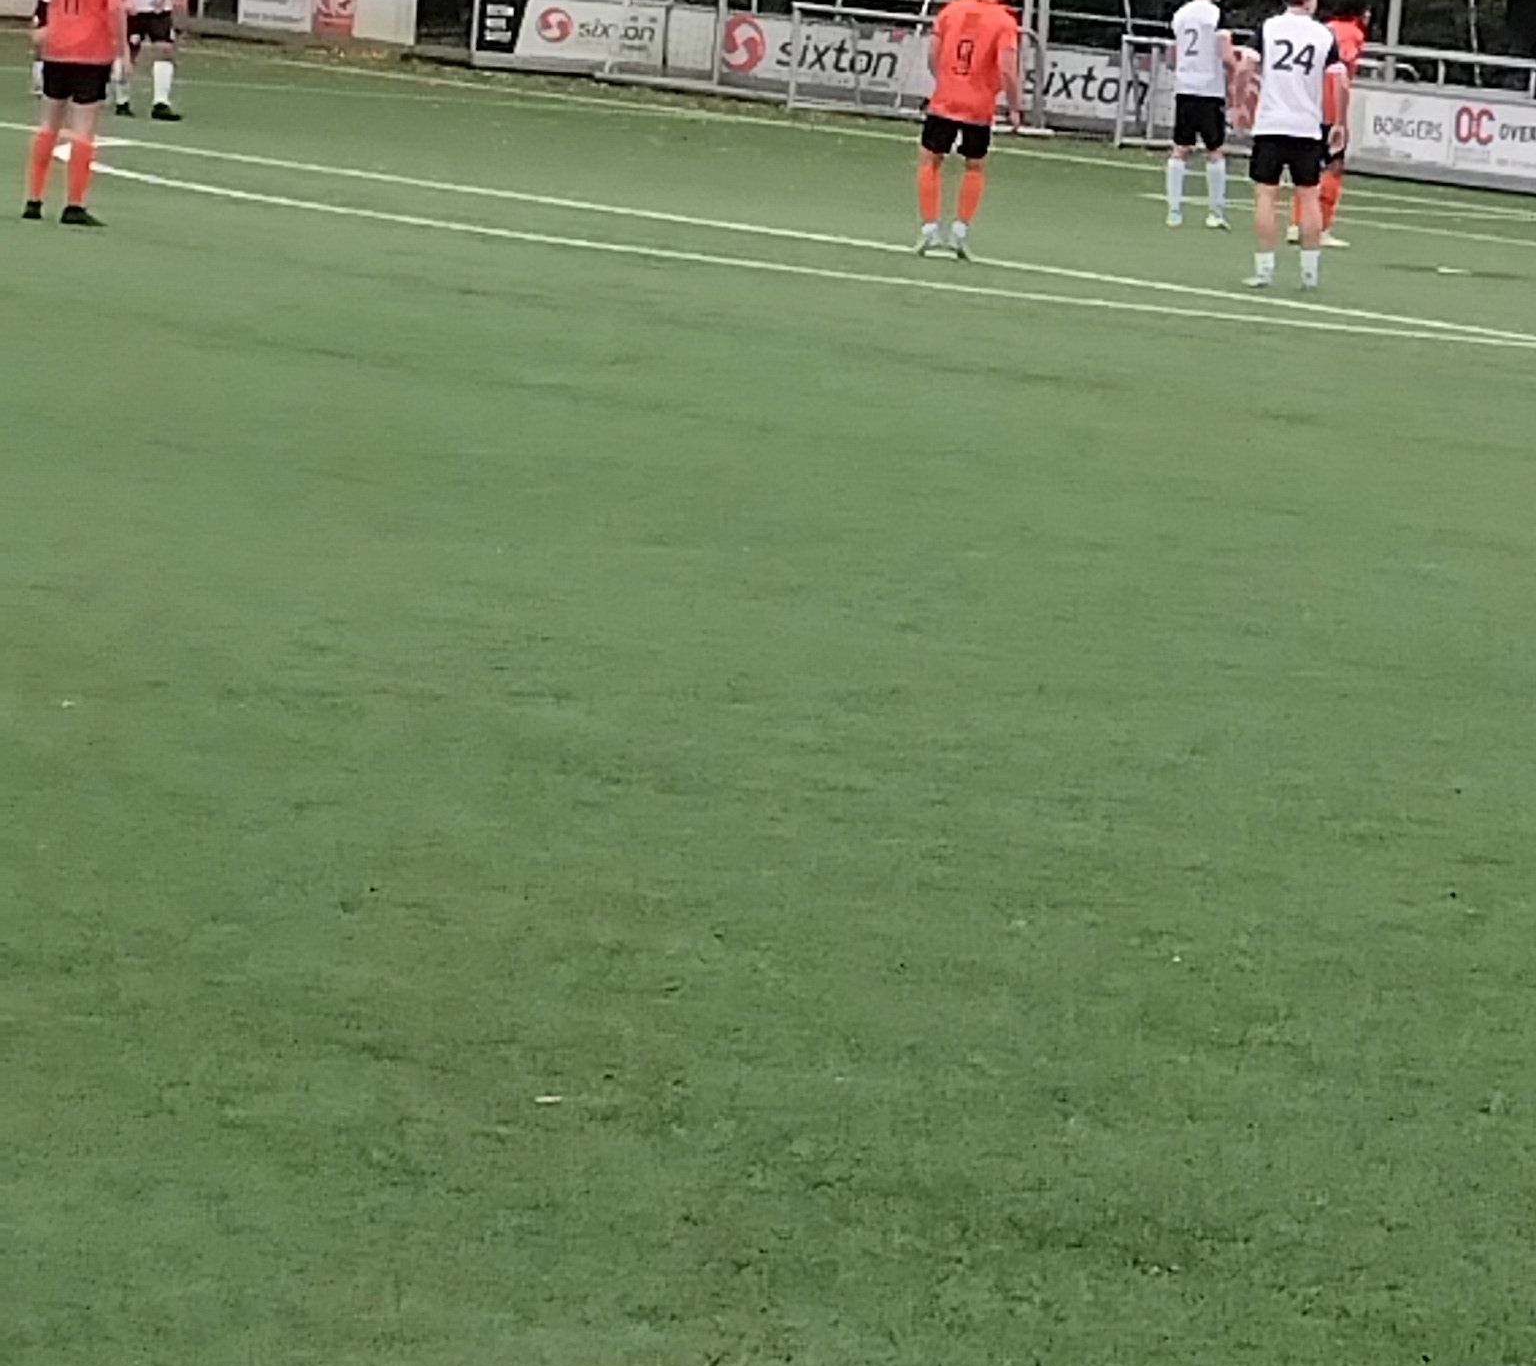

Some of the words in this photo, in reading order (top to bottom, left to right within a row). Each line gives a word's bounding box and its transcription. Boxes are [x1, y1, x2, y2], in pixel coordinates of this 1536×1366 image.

[578, 19, 656, 43] sixon
[1184, 28, 1200, 57] 2
[775, 34, 899, 79] sixton
[951, 39, 975, 76] 9
[1272, 39, 1316, 75] 24
[1373, 115, 1443, 143] BORGERS
[1455, 106, 1496, 146] OC
